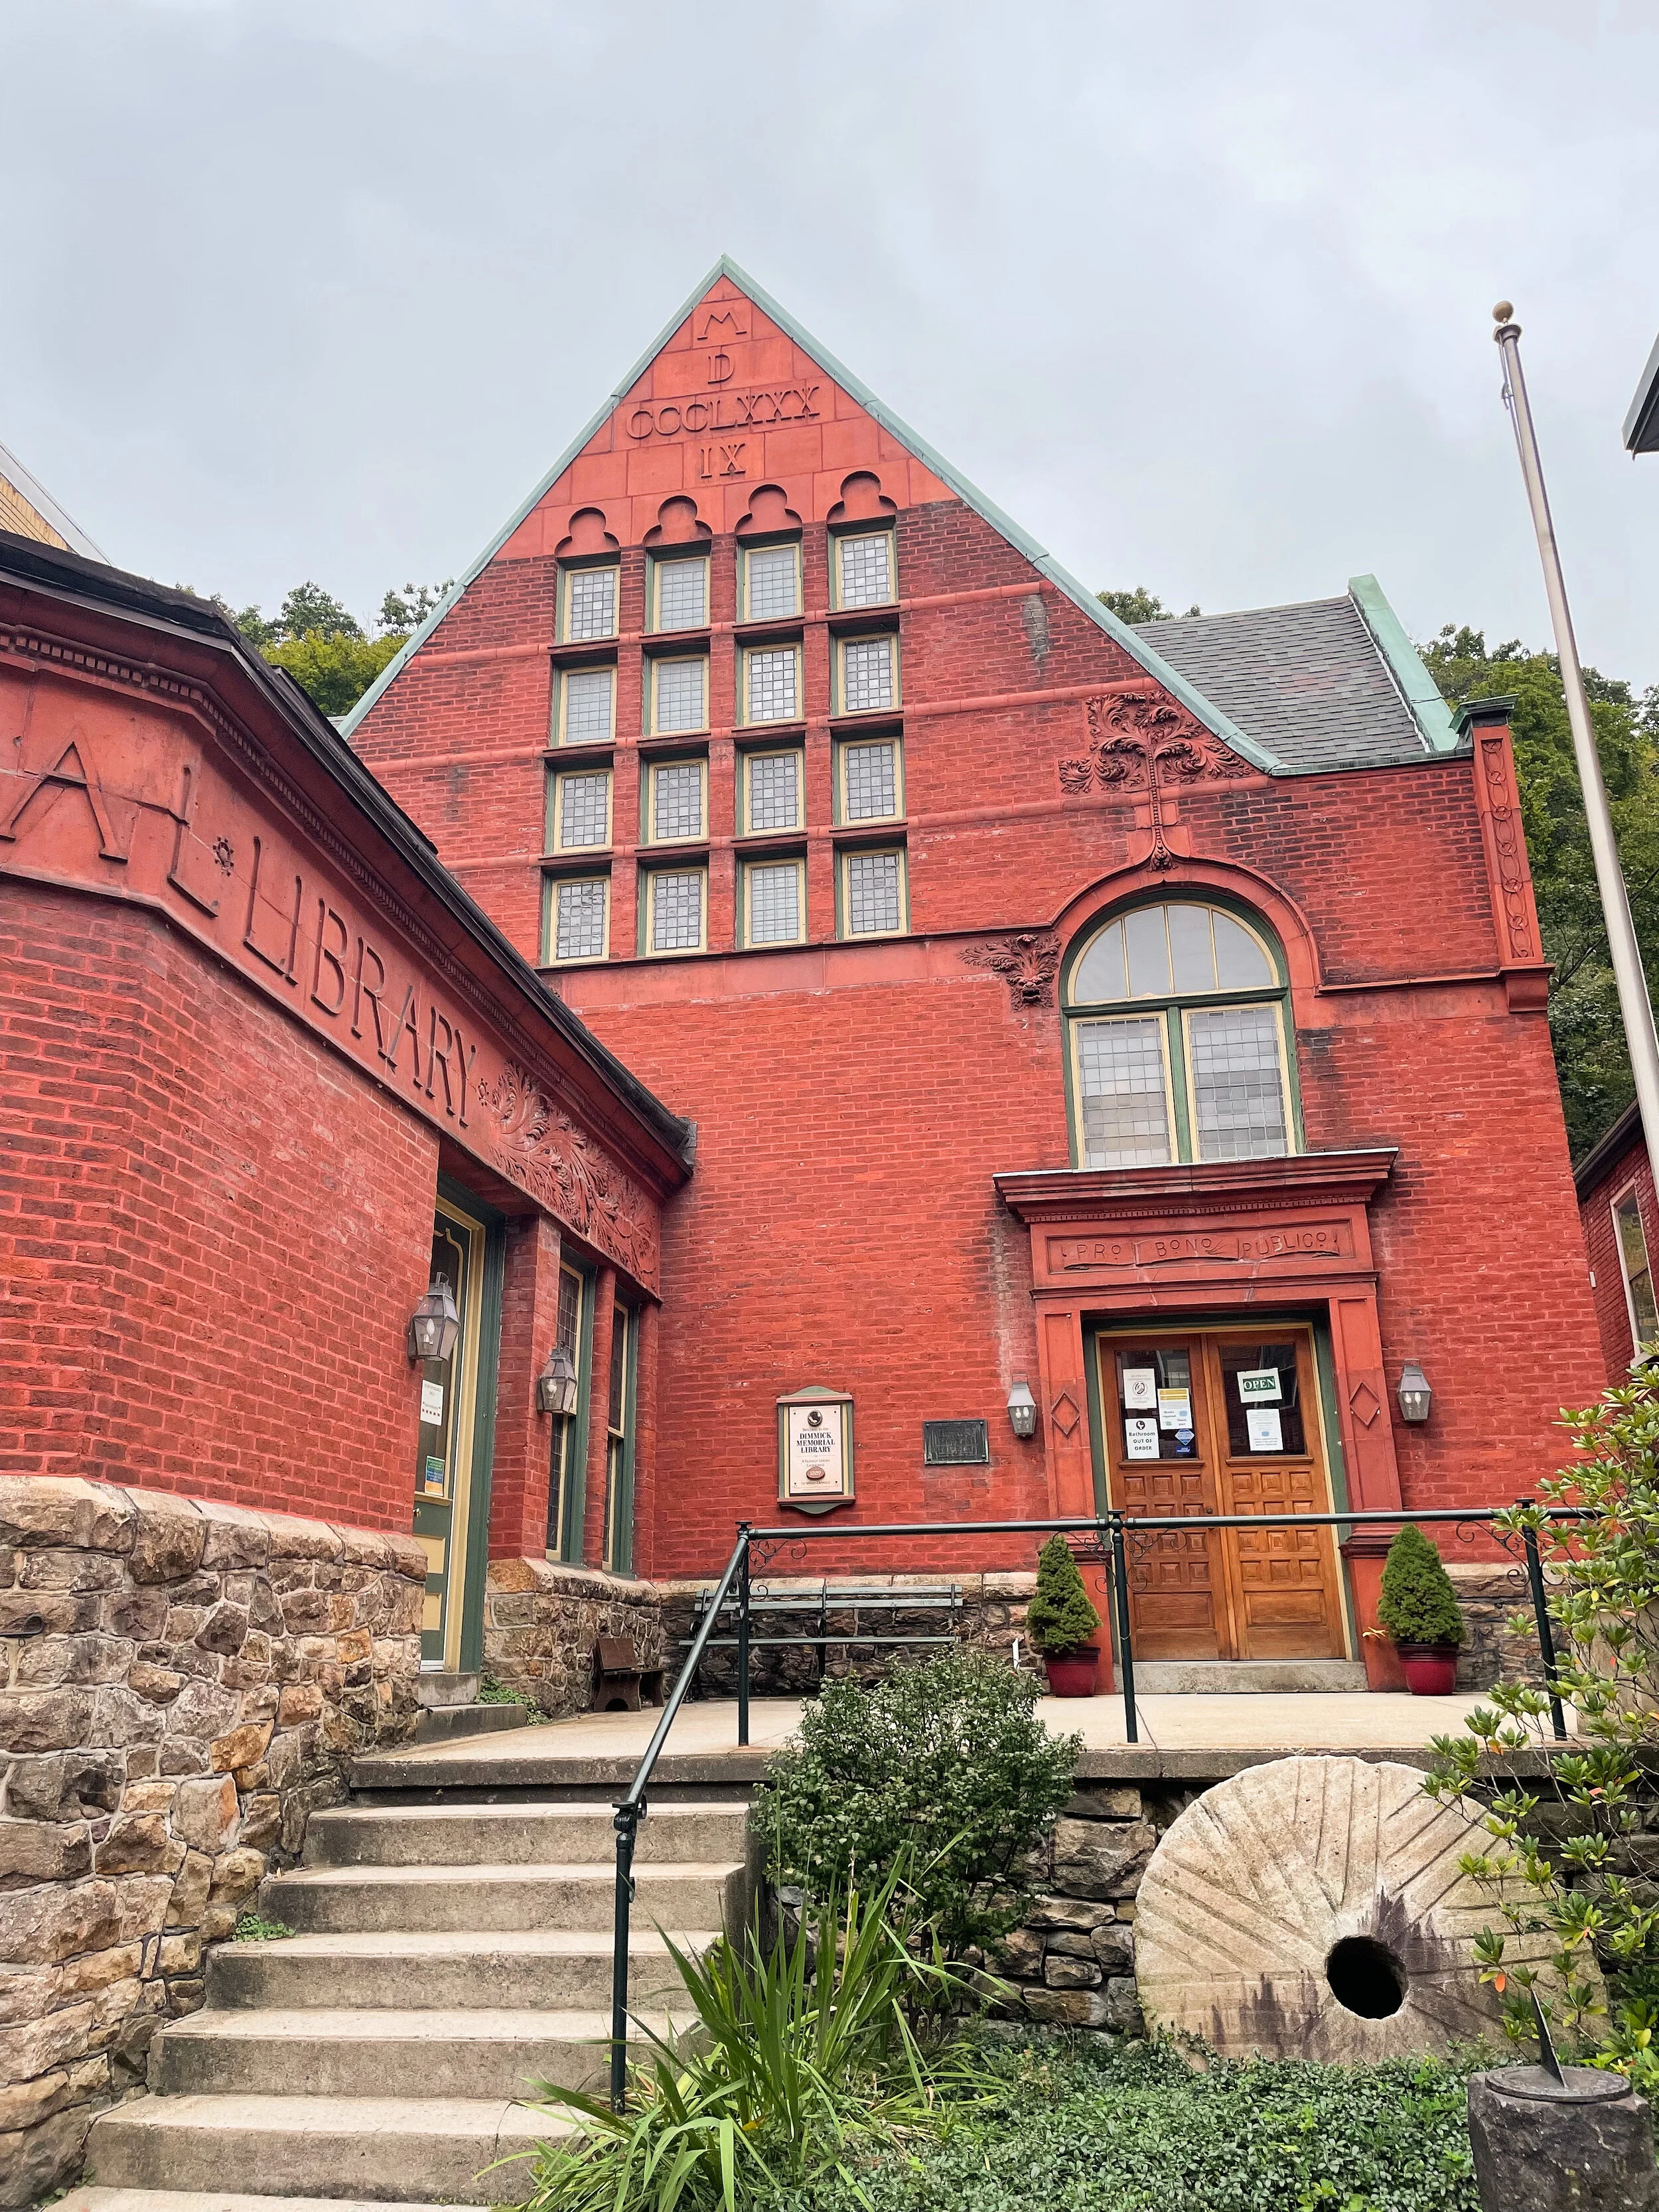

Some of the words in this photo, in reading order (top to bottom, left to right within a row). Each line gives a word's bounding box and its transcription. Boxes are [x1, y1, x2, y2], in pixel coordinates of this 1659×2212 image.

[697, 311, 747, 340] M
[707, 354, 735, 385] D
[626, 386, 820, 440] CCCLXXX
[700, 443, 747, 479] IX
[243, 836, 476, 1129] LIBRARY
[1076, 1244, 1121, 1260] PRO
[1155, 1238, 1212, 1257] BONO
[1242, 1232, 1327, 1259] PUBLICO
[1244, 1378, 1275, 1390] OPEN
